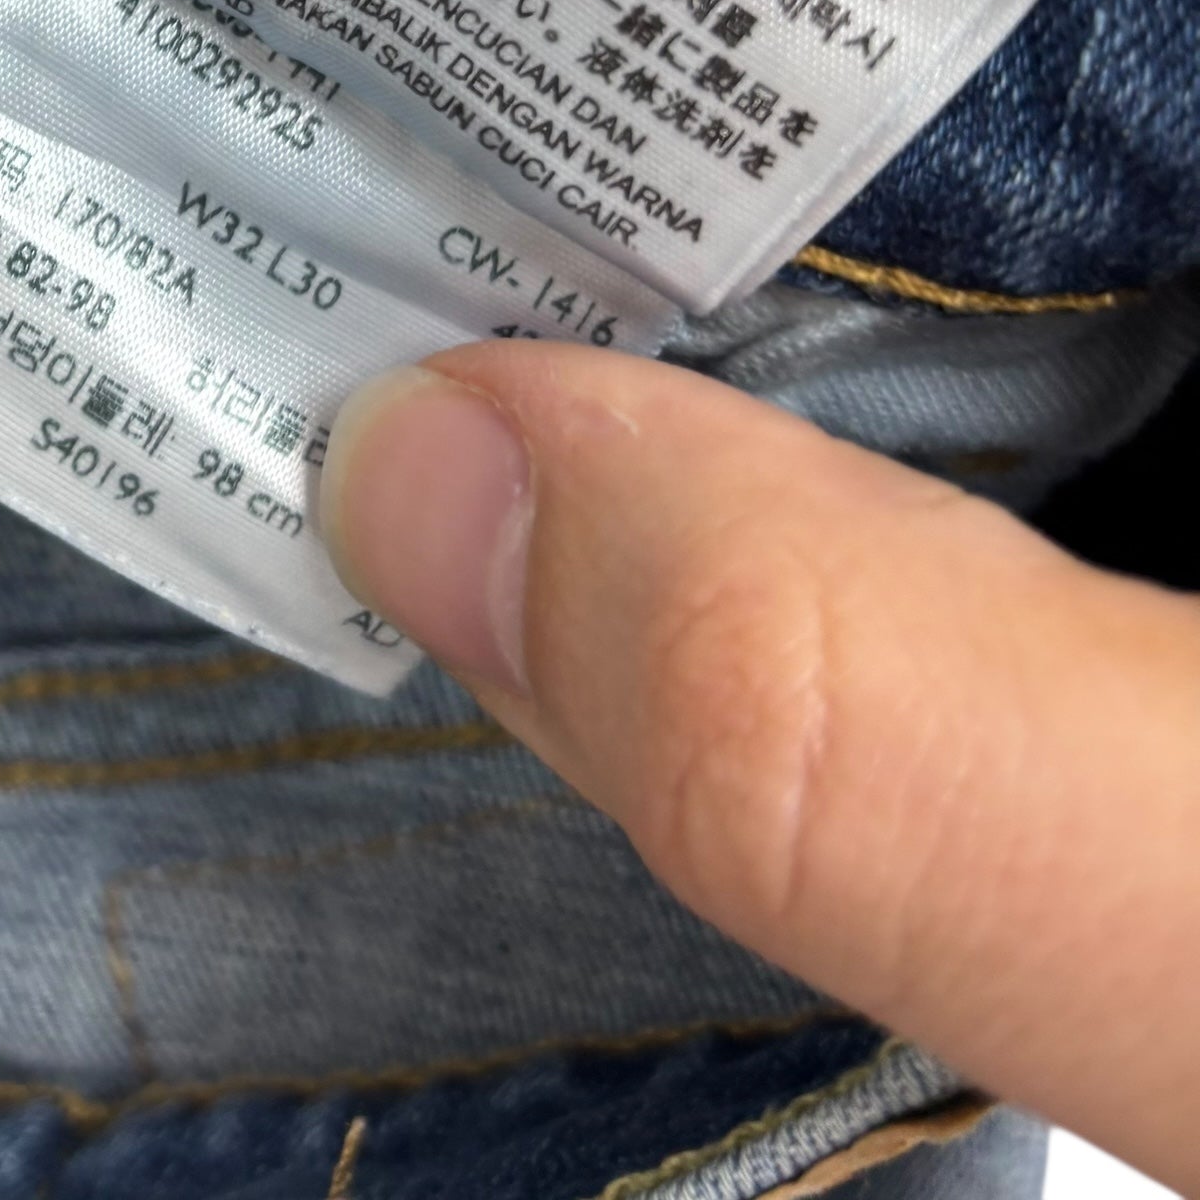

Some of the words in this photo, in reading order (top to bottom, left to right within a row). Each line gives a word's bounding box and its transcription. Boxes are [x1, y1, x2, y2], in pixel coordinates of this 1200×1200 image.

[372, 42, 475, 131] SABUN
[474, 122, 555, 191] CUCI
[554, 180, 647, 252] CAIR.
[445, 51, 582, 162] DENGAN
[580, 149, 708, 243] WARNA
[570, 93, 646, 156] DAN
[2, 237, 120, 332] 82-98
[52, 189, 208, 305] 170/82A
[169, 181, 268, 264] W32
[265, 245, 347, 313] L30
[431, 219, 529, 296] CW-
[530, 276, 624, 351] 1416
[28, 415, 164, 520] S40196
[341, 603, 405, 654] AD
[187, 445, 247, 501] 98
[243, 487, 307, 538] cm
